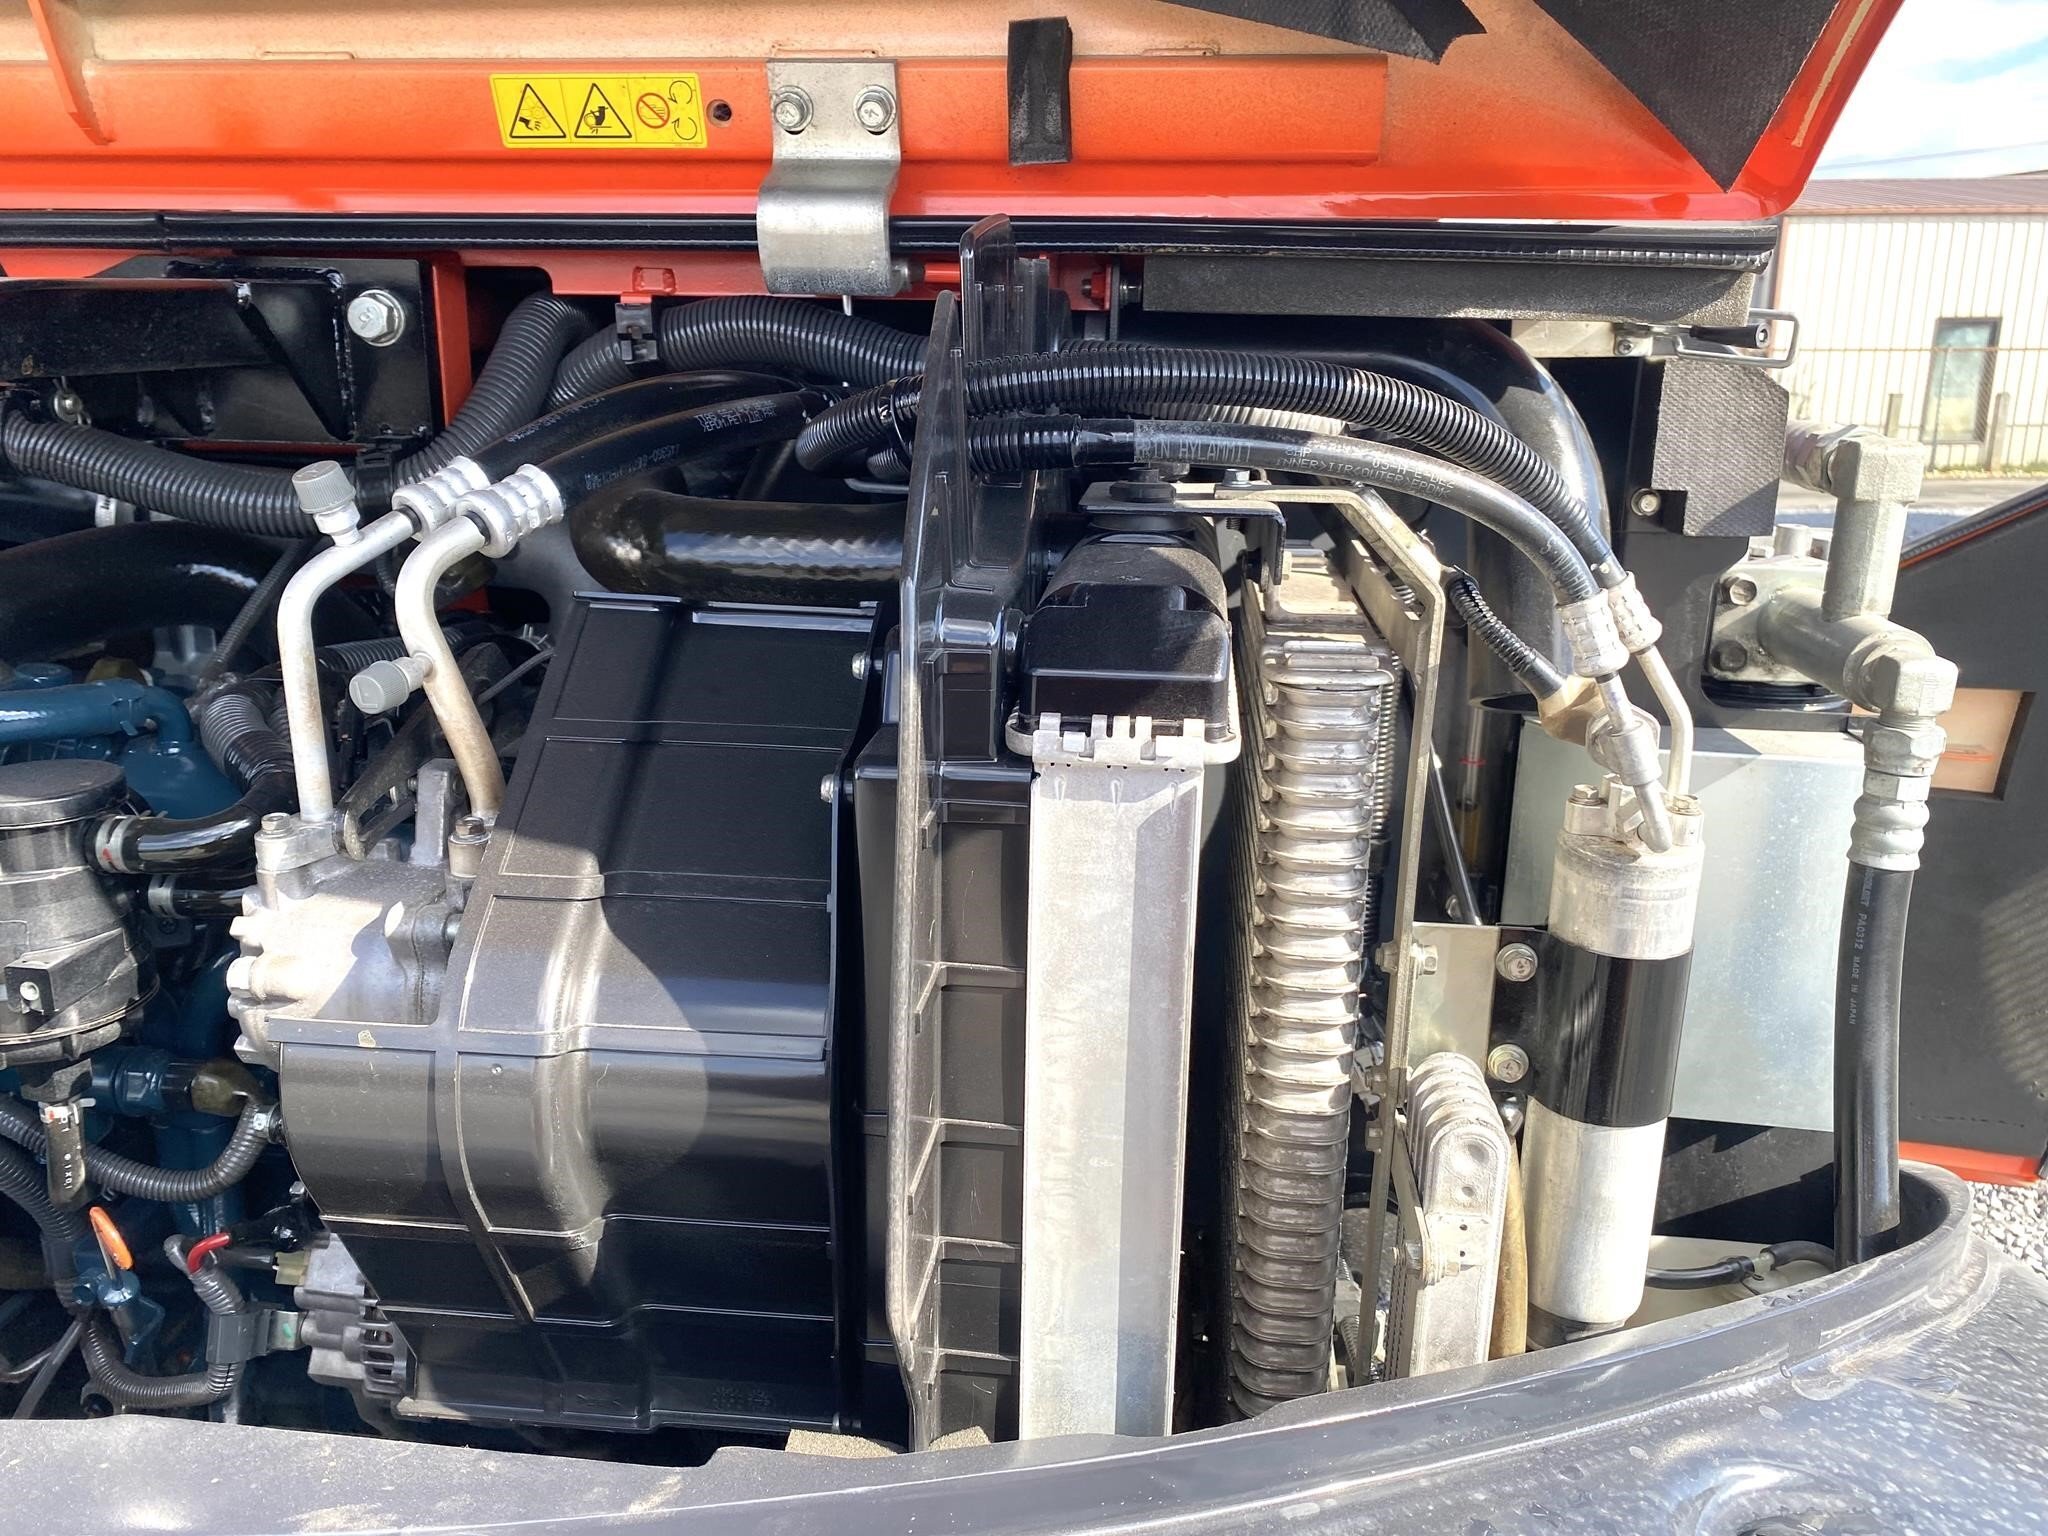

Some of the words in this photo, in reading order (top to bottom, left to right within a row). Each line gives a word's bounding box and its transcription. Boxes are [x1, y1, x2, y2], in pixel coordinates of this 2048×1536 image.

[1850, 956, 1860, 979] MADE
[1850, 984, 1859, 993] IN
[1848, 997, 1857, 1025] JAPAN
